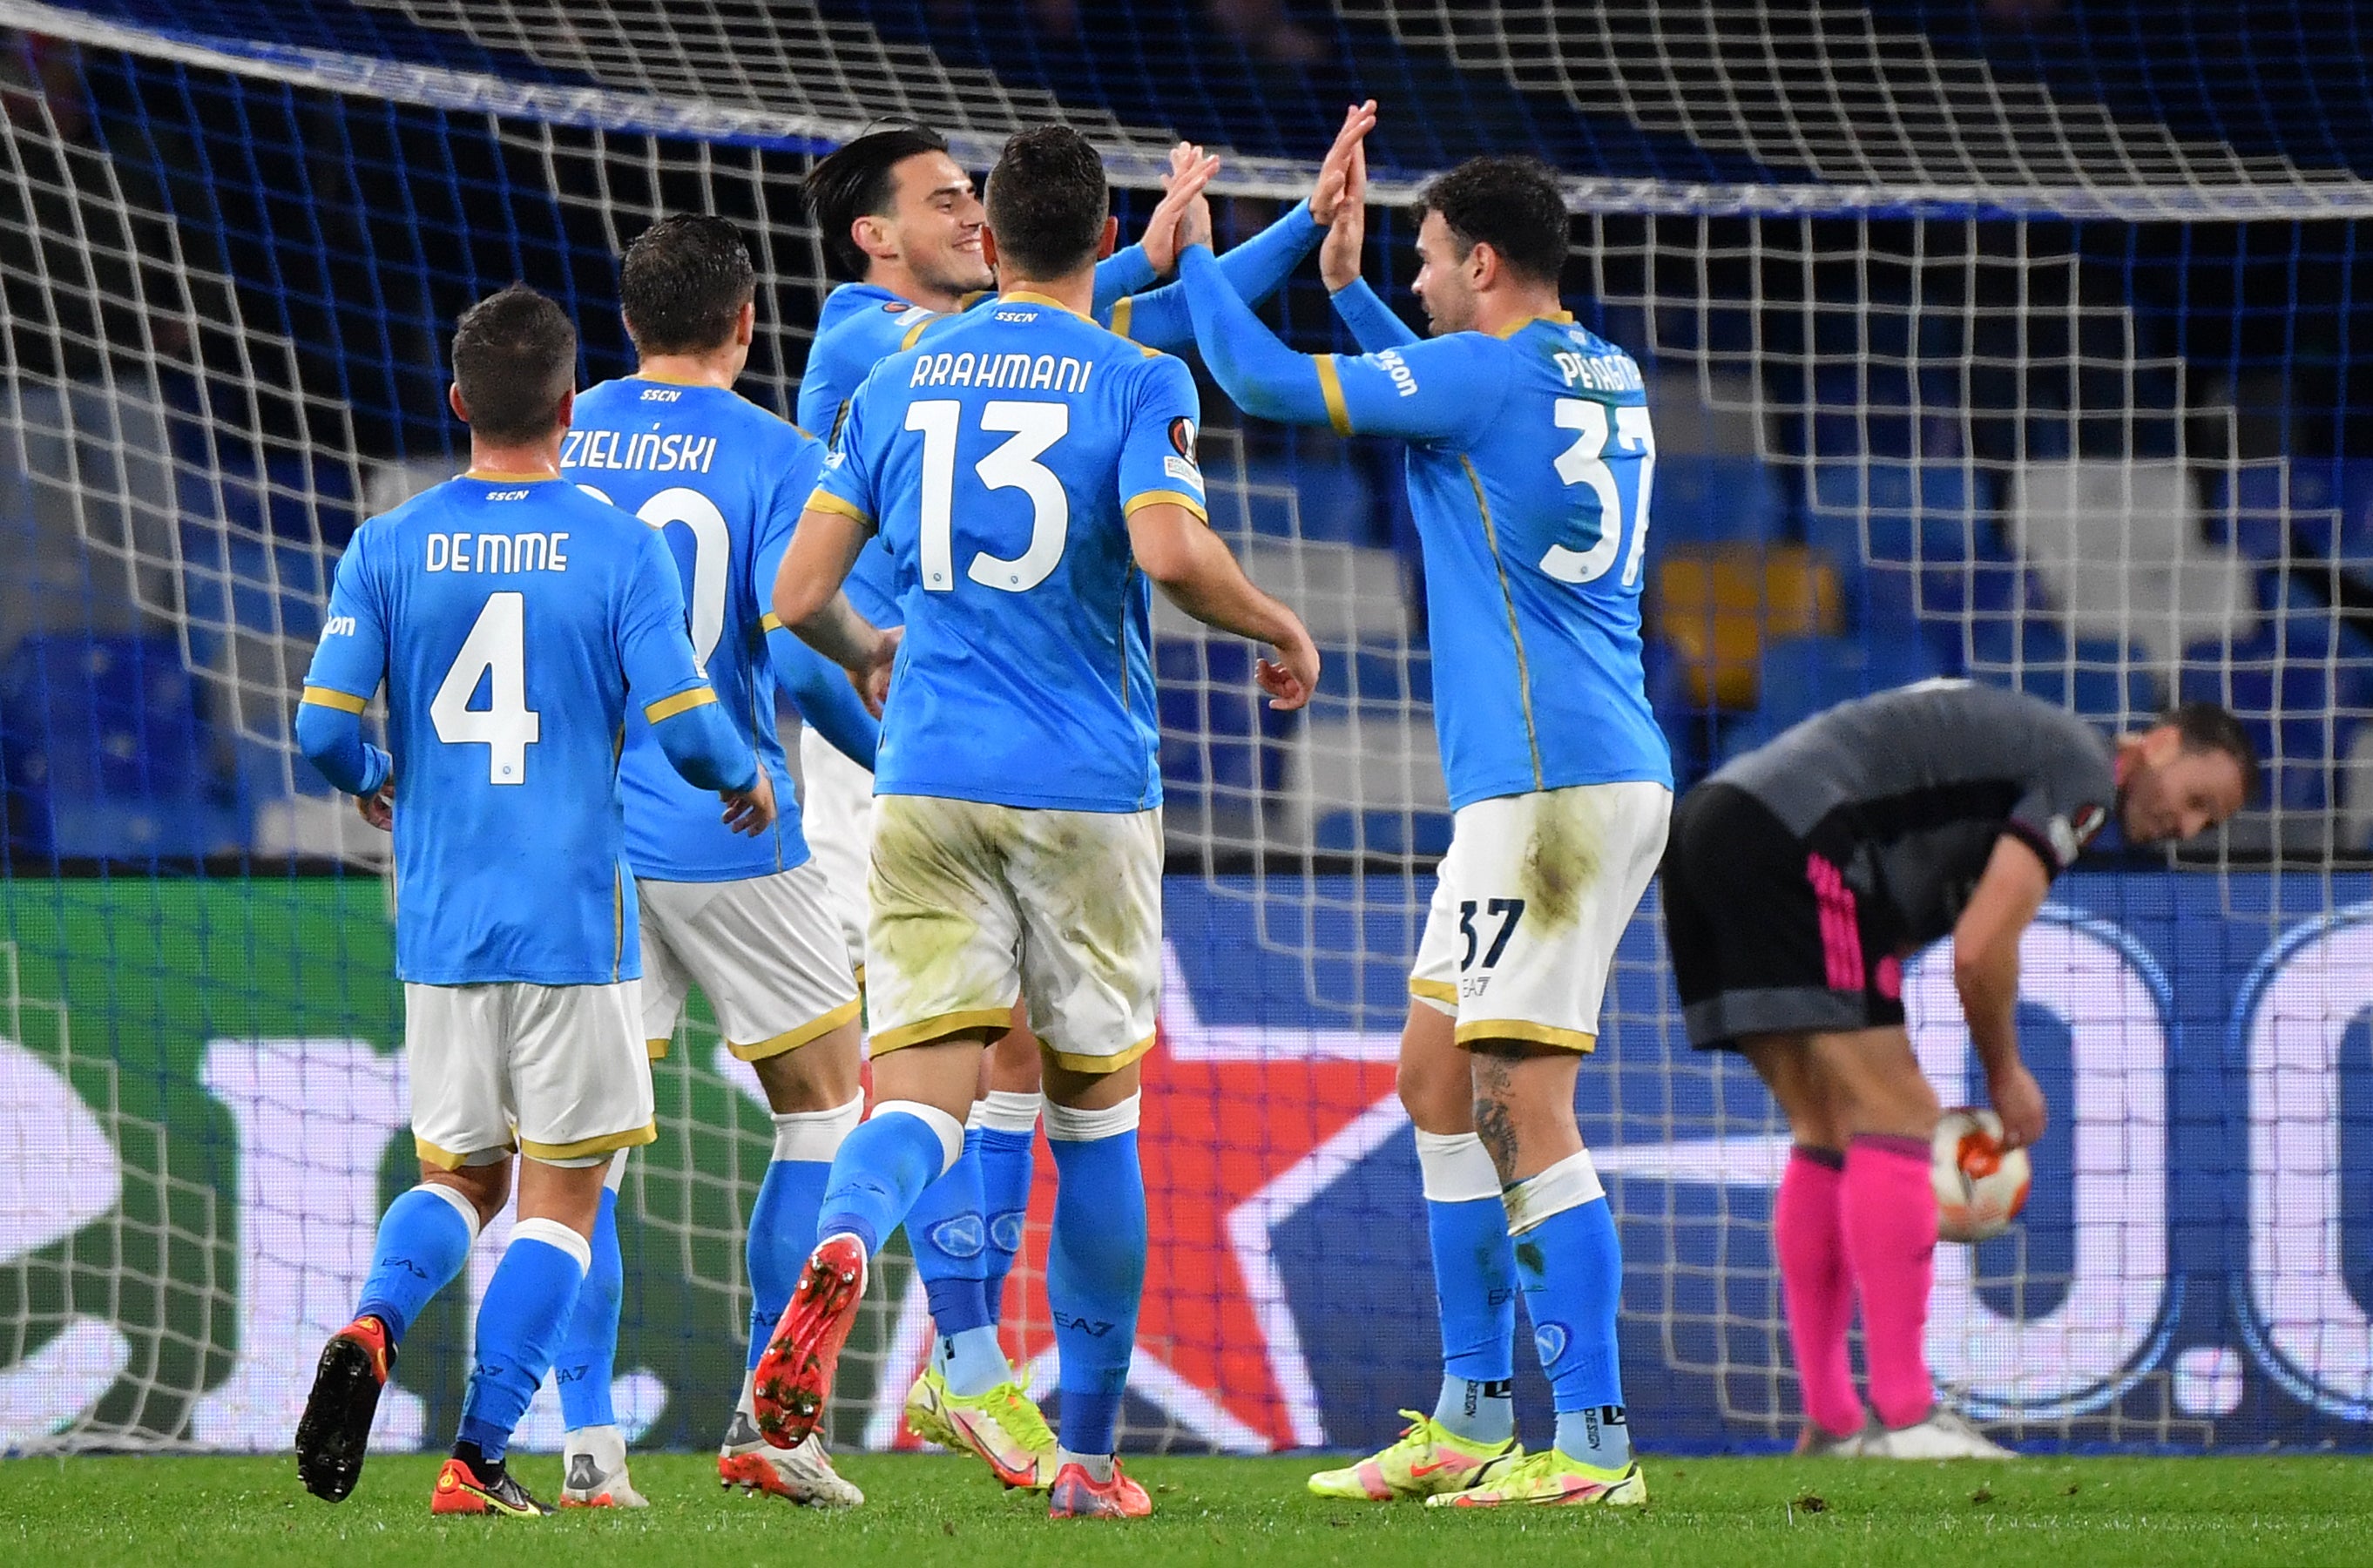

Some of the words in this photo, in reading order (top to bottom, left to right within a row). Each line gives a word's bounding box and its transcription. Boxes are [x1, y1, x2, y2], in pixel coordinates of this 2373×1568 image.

[994, 311, 1038, 322] SSCN
[909, 352, 1092, 394] RRAHMANI
[639, 389, 680, 402] SSCN
[559, 422, 717, 474] ZIELIŃSKI
[485, 490, 530, 501] SSCN
[904, 399, 1069, 592] 13
[1538, 397, 1655, 585] 37
[426, 532, 569, 572] DEMME
[576, 483, 730, 669] 0
[326, 616, 355, 637] on
[429, 591, 539, 786] 4
[1460, 898, 1525, 973] 37
[1488, 1286, 1514, 1306] EA
[1053, 1310, 1115, 1337] EA7
[477, 1363, 504, 1375] A7
[1585, 1408, 1602, 1451] DESIGN
